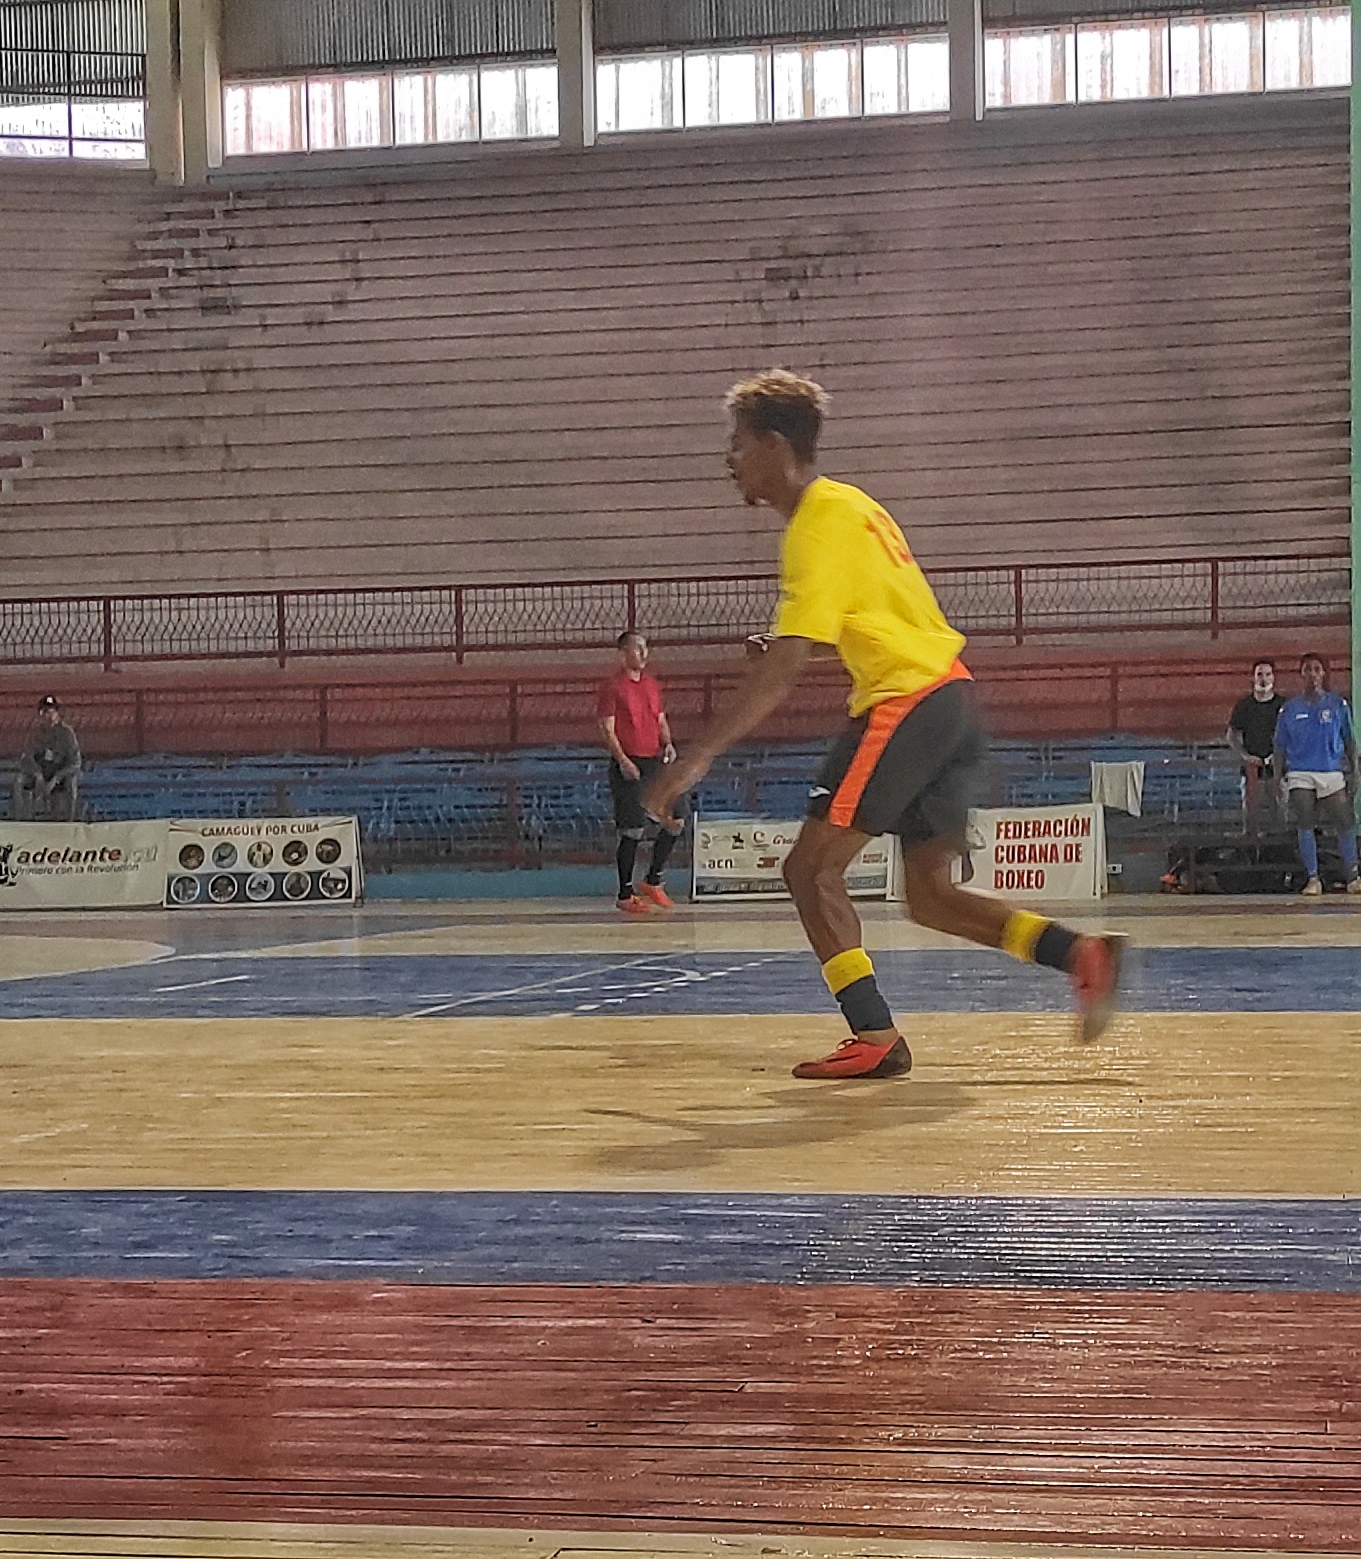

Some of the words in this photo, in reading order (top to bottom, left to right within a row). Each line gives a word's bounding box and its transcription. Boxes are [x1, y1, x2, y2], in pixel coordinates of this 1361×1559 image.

[265, 824, 287, 836] POR
[290, 823, 320, 835] CUBA
[995, 813, 1091, 840] FEDERACIÓN
[994, 843, 1060, 864] CUBANA
[1063, 842, 1083, 863] DE
[993, 868, 1046, 890] BOXEO
